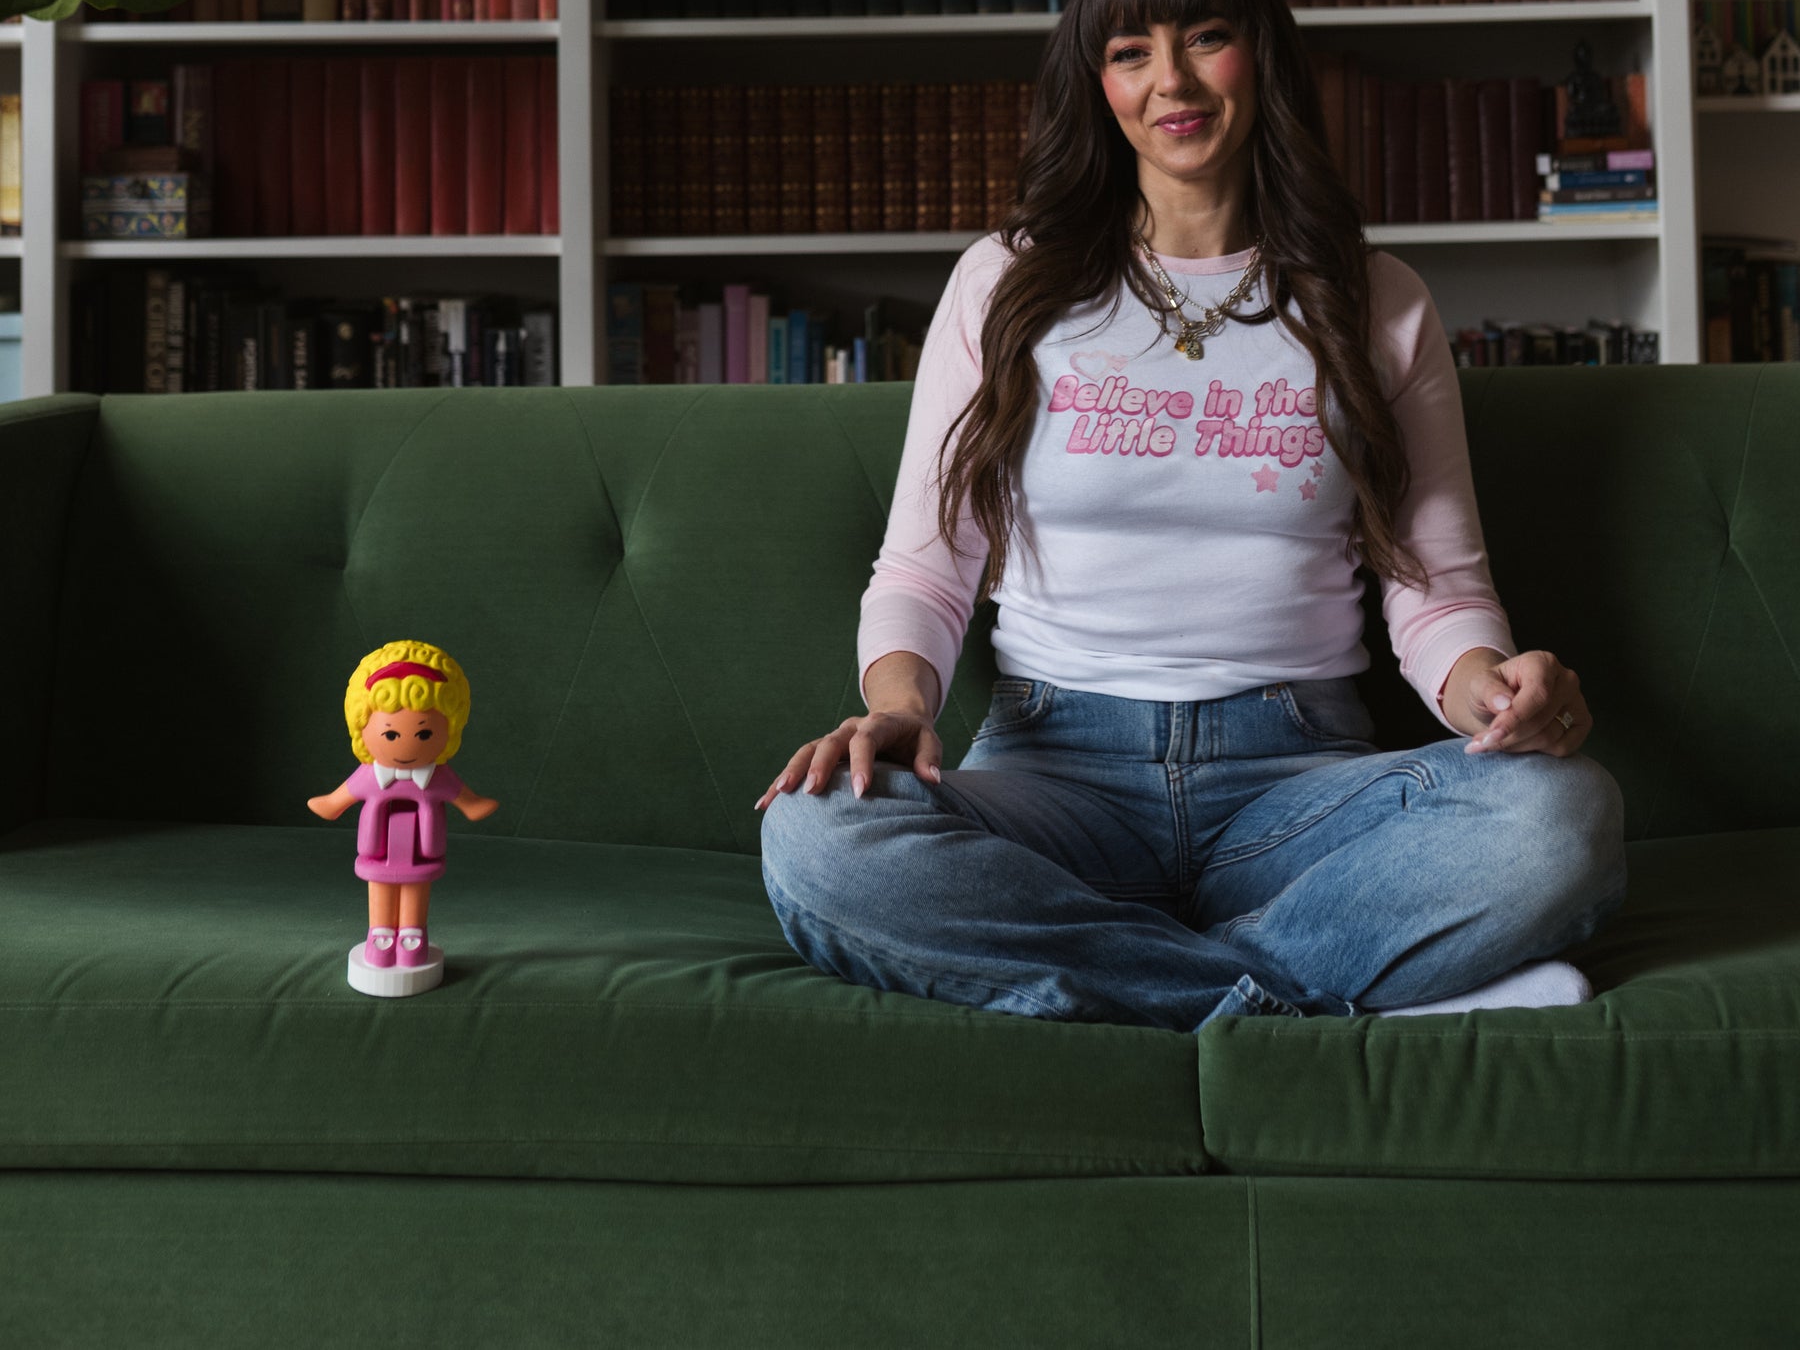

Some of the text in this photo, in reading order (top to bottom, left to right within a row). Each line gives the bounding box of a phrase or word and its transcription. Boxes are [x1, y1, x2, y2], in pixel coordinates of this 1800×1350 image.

[1048, 374, 1317, 419] Believe in the
[1066, 413, 1325, 467] Little Things
